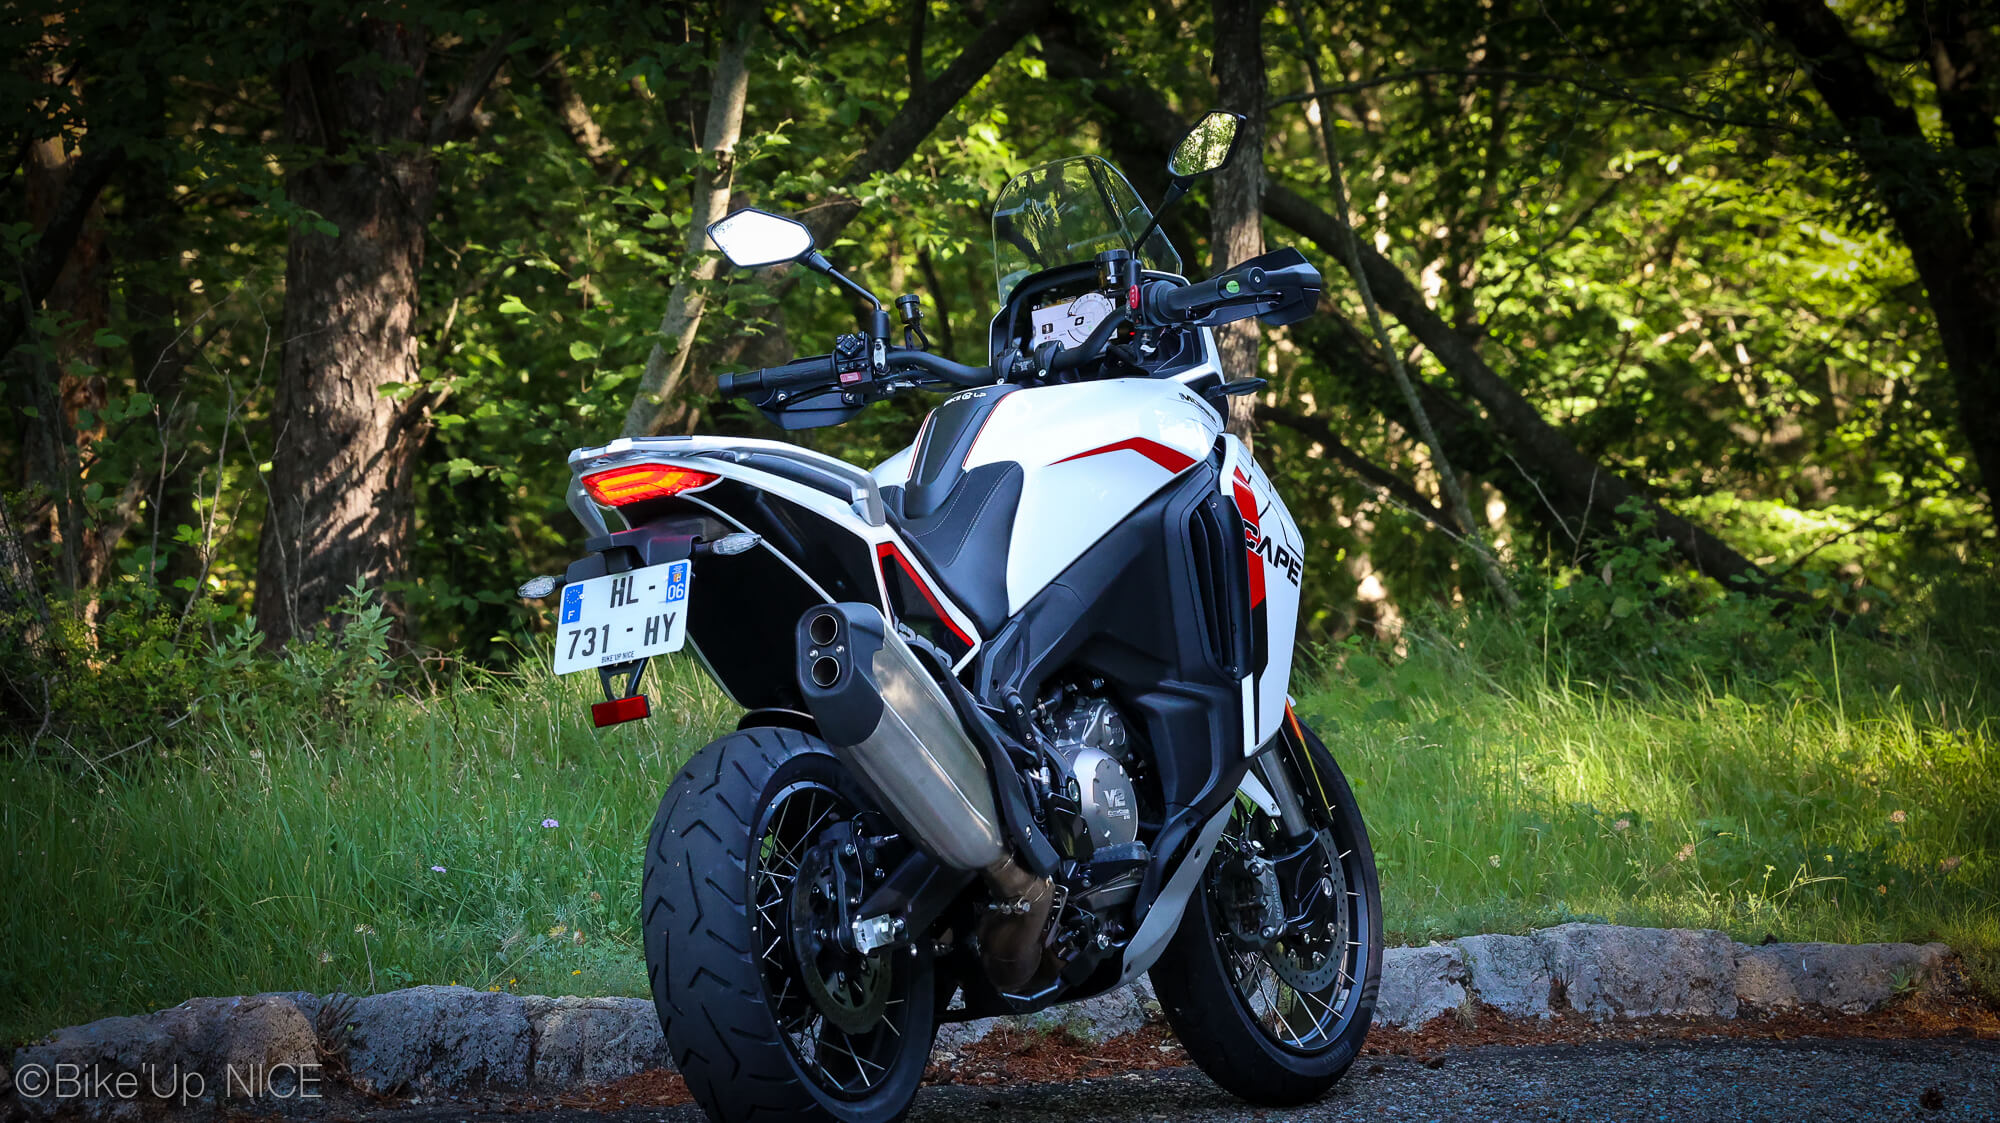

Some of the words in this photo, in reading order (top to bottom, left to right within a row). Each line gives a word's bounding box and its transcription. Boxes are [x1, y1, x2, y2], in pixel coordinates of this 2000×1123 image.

[609, 575, 639, 609] HL
[667, 583, 684, 600] 06
[567, 610, 575, 621] F
[567, 624, 610, 660] 731
[643, 612, 676, 647] HY
[1104, 788, 1126, 808] V2
